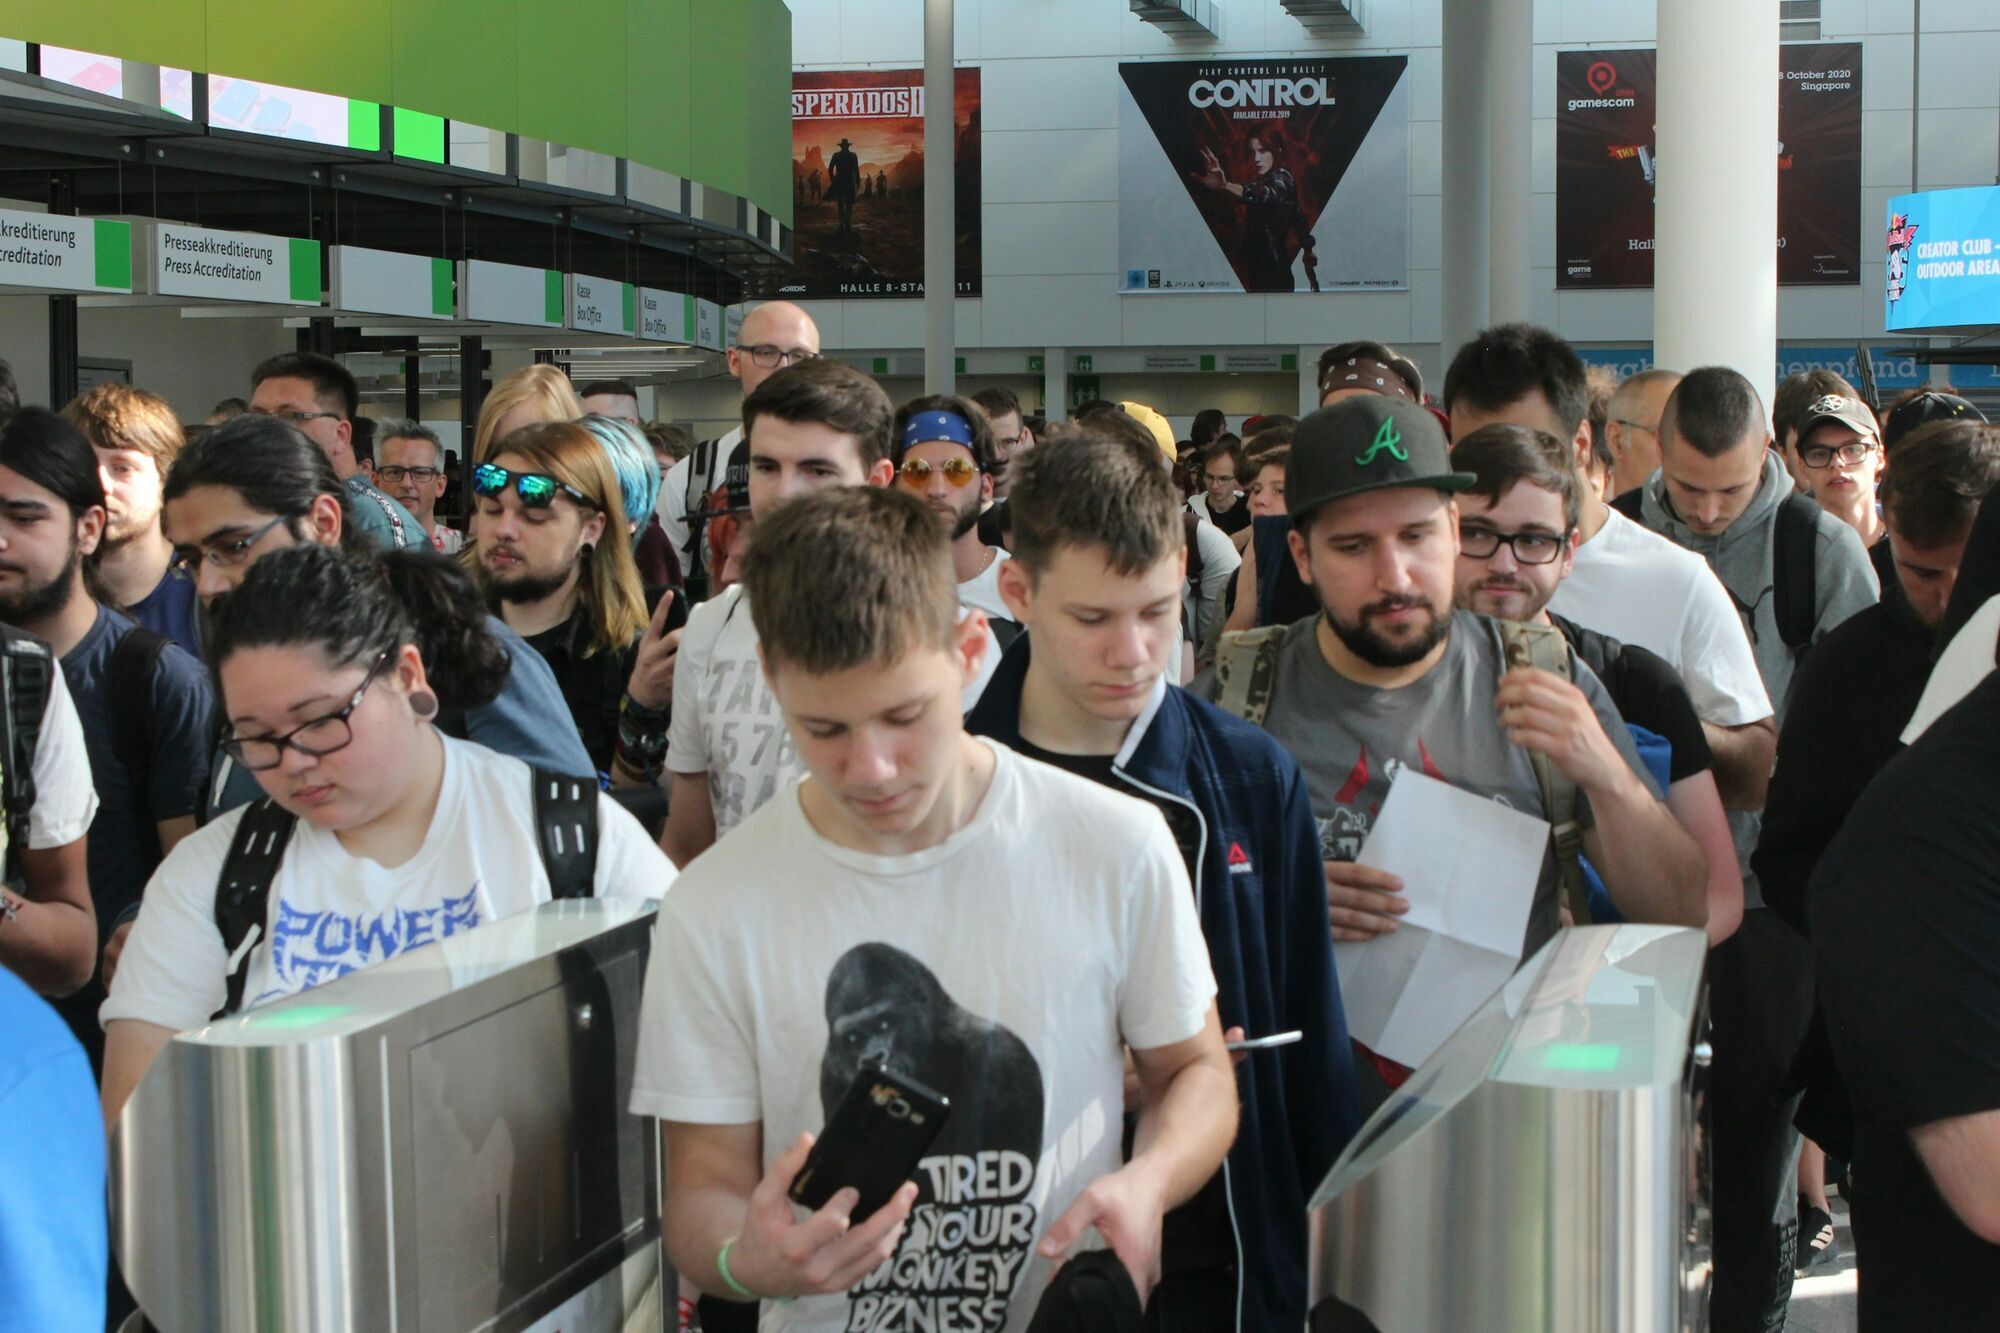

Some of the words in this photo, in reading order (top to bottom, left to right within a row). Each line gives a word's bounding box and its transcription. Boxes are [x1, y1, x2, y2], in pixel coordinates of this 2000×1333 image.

[1200, 68, 1221, 76] PLAY
[1228, 66, 1269, 75] CONTROL
[1277, 66, 1286, 74] IN
[1293, 66, 1315, 74] HALL
[1786, 71, 1825, 80] October
[1827, 69, 1851, 79] 2020
[1188, 77, 1336, 108] CONTROL
[1801, 82, 1851, 92] Singapore
[1567, 98, 1635, 111] gamescom
[1233, 111, 1260, 119] AVAILABLE
[0, 219, 76, 249] kreditierung
[164, 233, 273, 265] Presseakkreditierung
[1917, 241, 1959, 258] CREATOR
[1961, 239, 1992, 255] CLUB
[164, 257, 192, 274] Press
[193, 260, 261, 282] Accreditation
[1916, 261, 1965, 279] OUTDOOR
[577, 282, 591, 299] Kasse
[840, 284, 880, 293] HALLE
[274, 881, 481, 964] POWER
[918, 1150, 1033, 1204] TIRED
[913, 1203, 1032, 1250] YOUR
[850, 1297, 1007, 1333] BIZNESS
